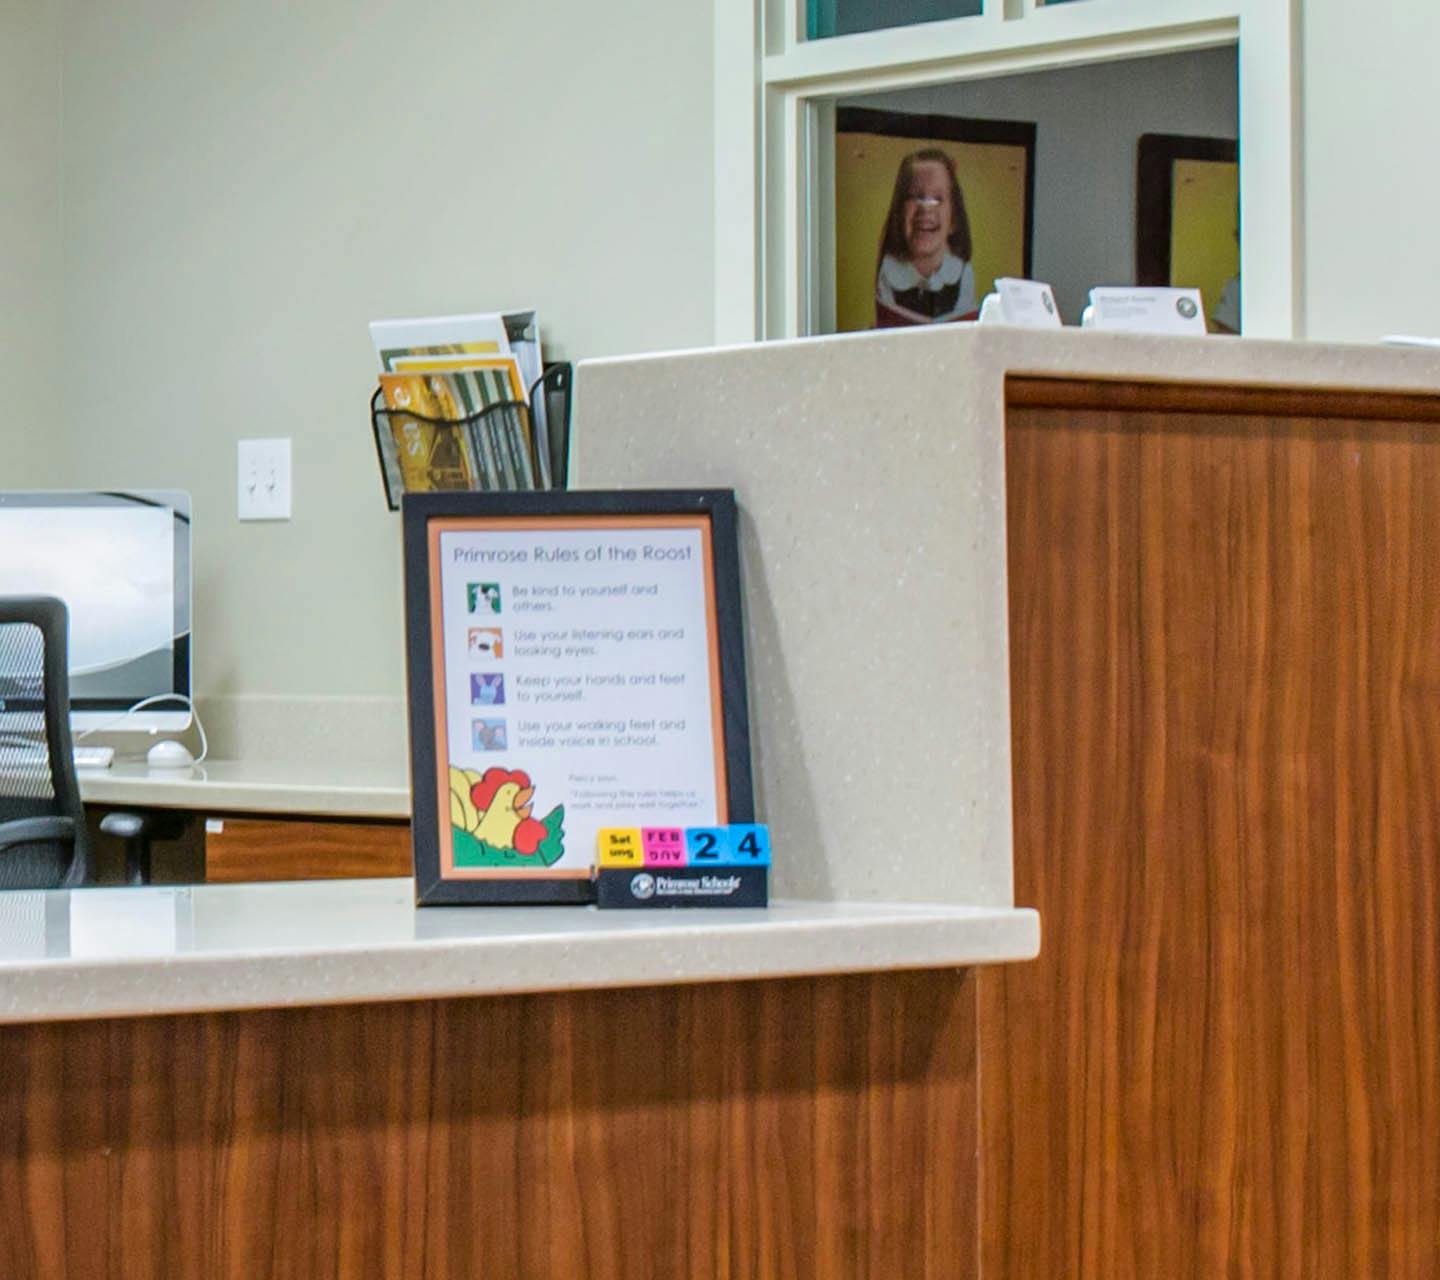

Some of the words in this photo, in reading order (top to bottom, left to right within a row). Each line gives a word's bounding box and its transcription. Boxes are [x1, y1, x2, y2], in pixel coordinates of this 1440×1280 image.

[453, 546, 528, 563] Primrose
[534, 546, 579, 562] Rules
[584, 545, 602, 561] of
[608, 545, 636, 561] the
[643, 545, 692, 560] Roost
[512, 586, 528, 596] Be
[532, 585, 558, 596] kind
[562, 585, 575, 596] to
[579, 584, 628, 597] yourself
[631, 584, 658, 595] and
[514, 630, 536, 640] Use
[540, 630, 568, 642] your
[572, 628, 624, 641] listening
[658, 628, 685, 639] and
[514, 646, 561, 658] looking
[516, 675, 550, 687] Keep
[554, 676, 581, 688] your
[586, 674, 626, 685] hands
[629, 674, 656, 685] and
[660, 673, 685, 684] feet
[517, 690, 530, 701] to
[518, 720, 541, 731] Use
[545, 721, 571, 733] your
[576, 720, 626, 733] walking
[629, 719, 655, 730] feet
[659, 719, 686, 730] and
[519, 735, 555, 746] inside
[559, 736, 595, 746] voice
[599, 735, 610, 746] in
[610, 834, 631, 844] Sat
[648, 832, 680, 842] FEB
